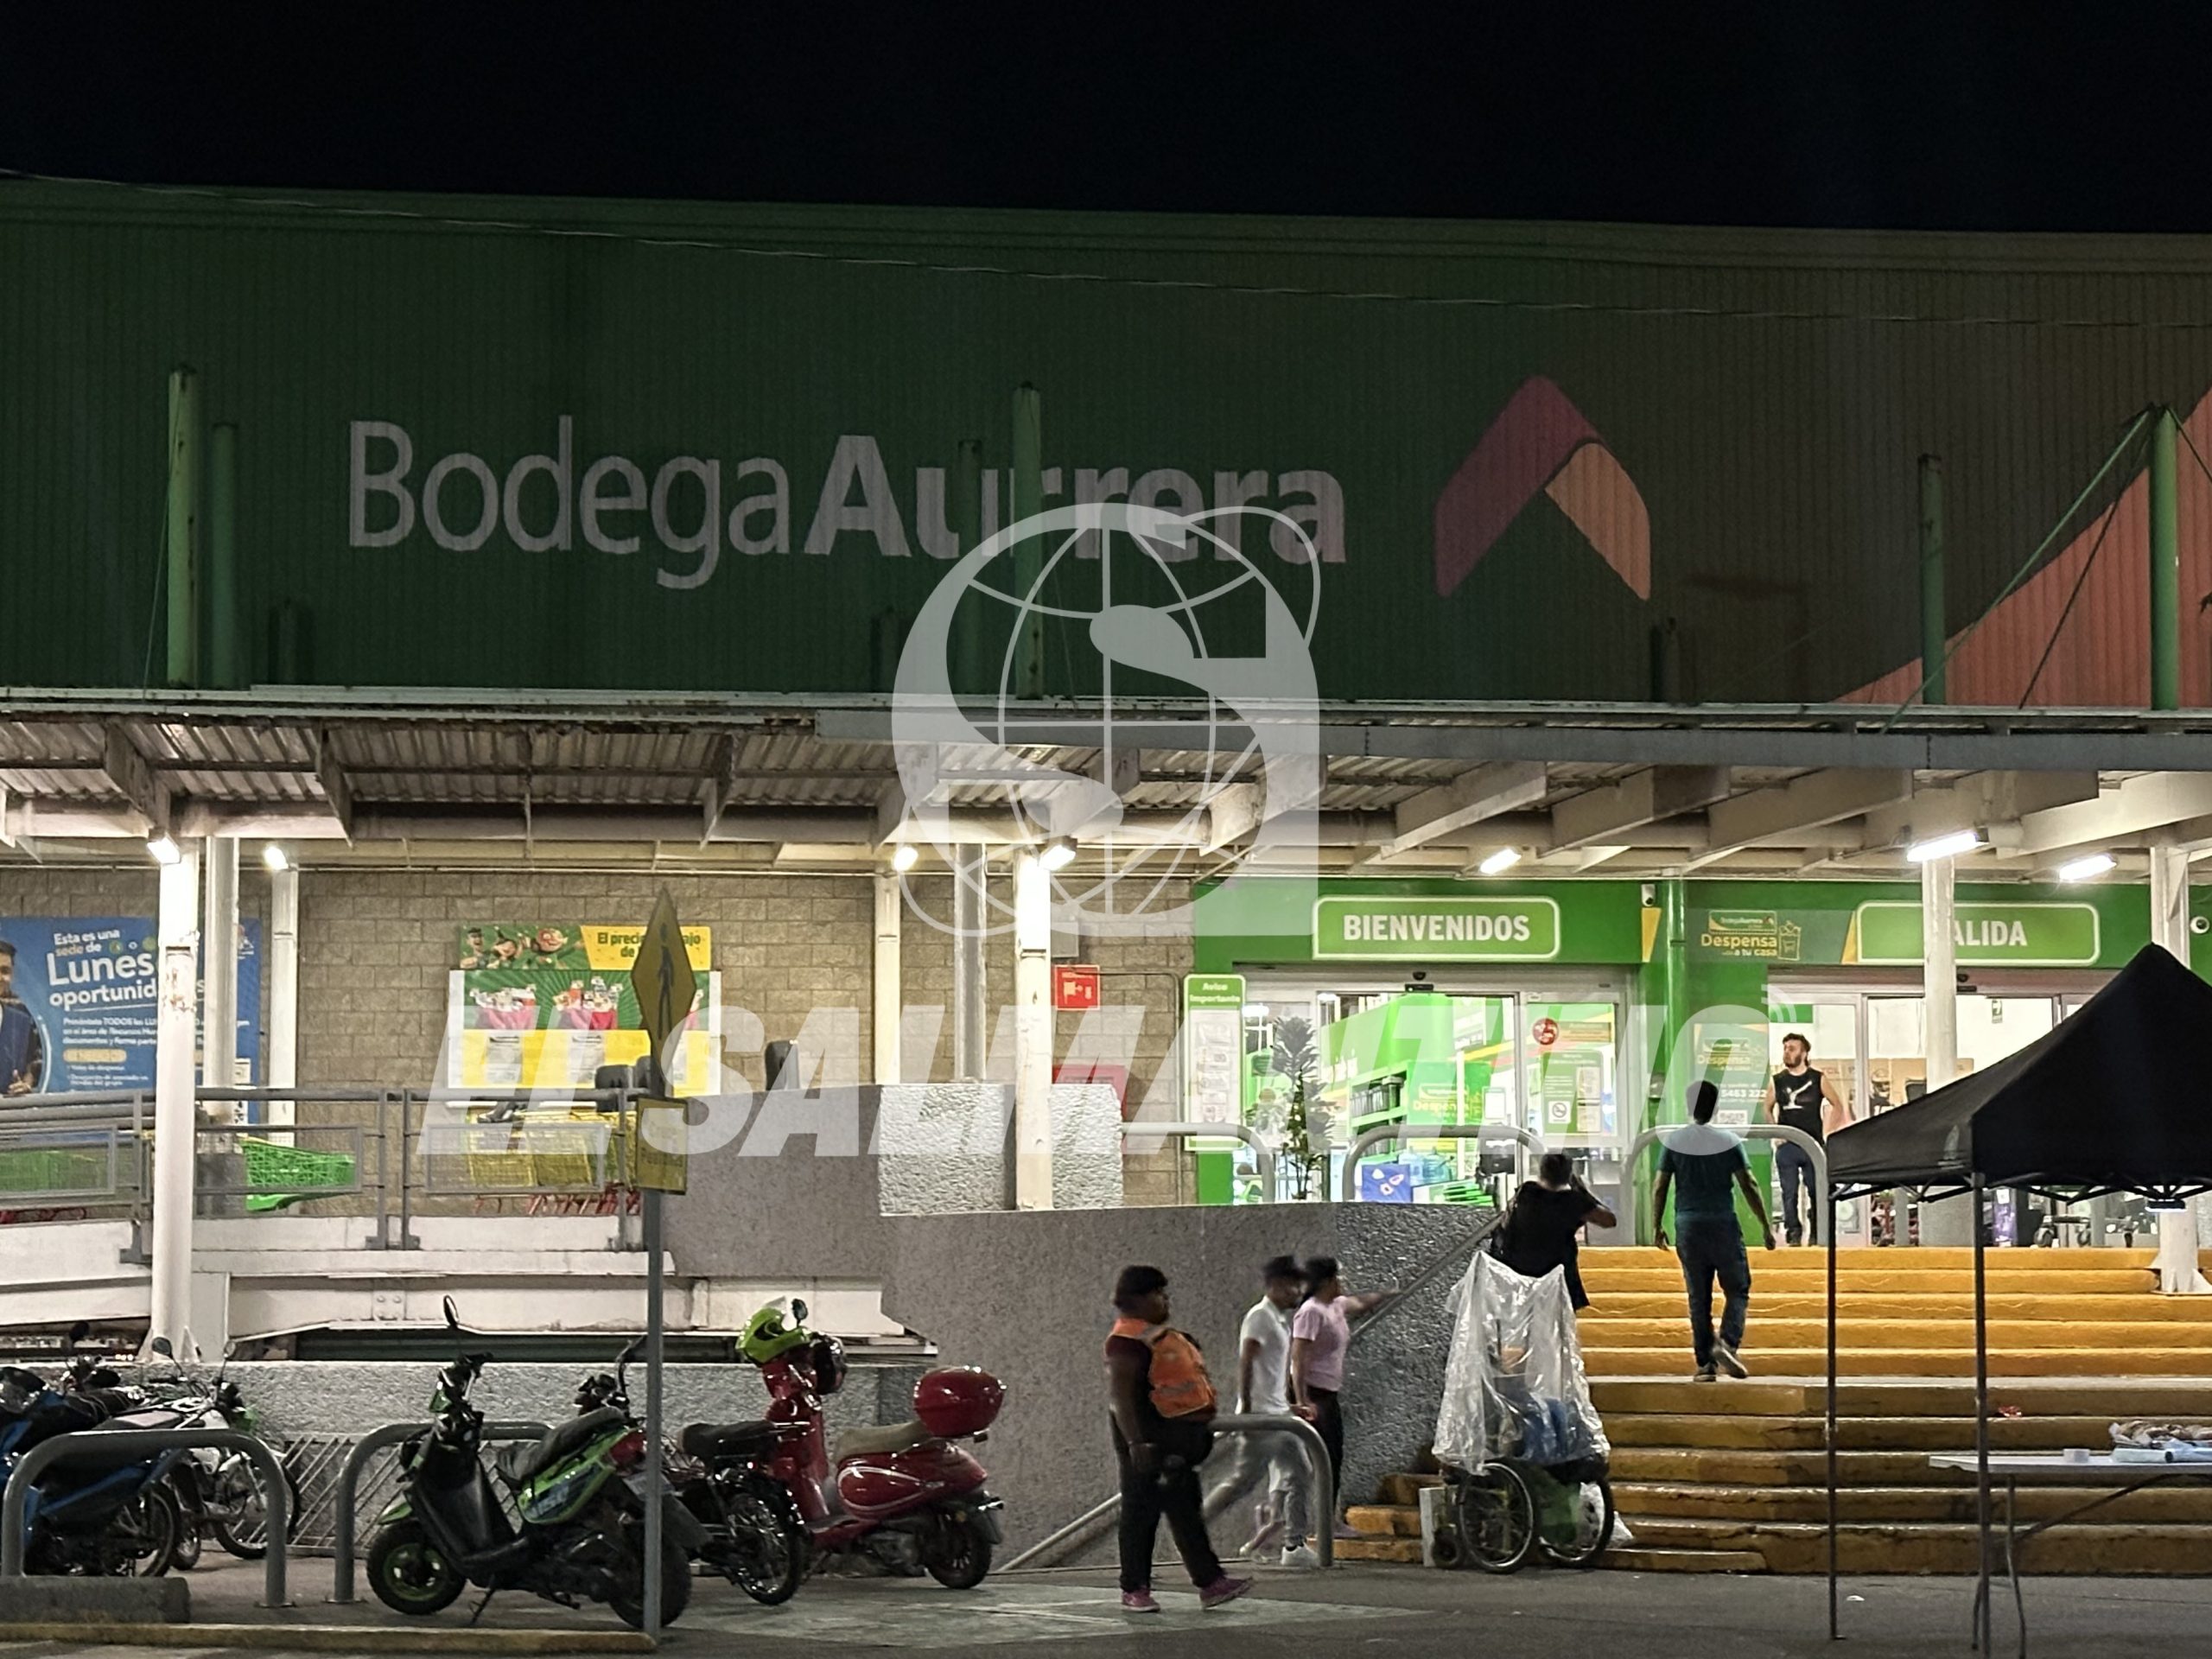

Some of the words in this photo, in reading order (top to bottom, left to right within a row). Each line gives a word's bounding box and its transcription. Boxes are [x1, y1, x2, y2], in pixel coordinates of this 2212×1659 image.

[1344, 914, 1530, 942] BIENVENIDOS
[1953, 920, 2028, 946] ALIDA
[54, 933, 79, 945] Esta
[82, 933, 96, 942] es
[97, 929, 120, 939] una
[597, 932, 608, 944] El
[1700, 933, 1777, 949] Despensa
[86, 942, 102, 952] de
[620, 946, 635, 957] de
[47, 952, 155, 986] Lunes
[1202, 982, 1228, 991] Aviso
[1189, 995, 1241, 1004] Importante
